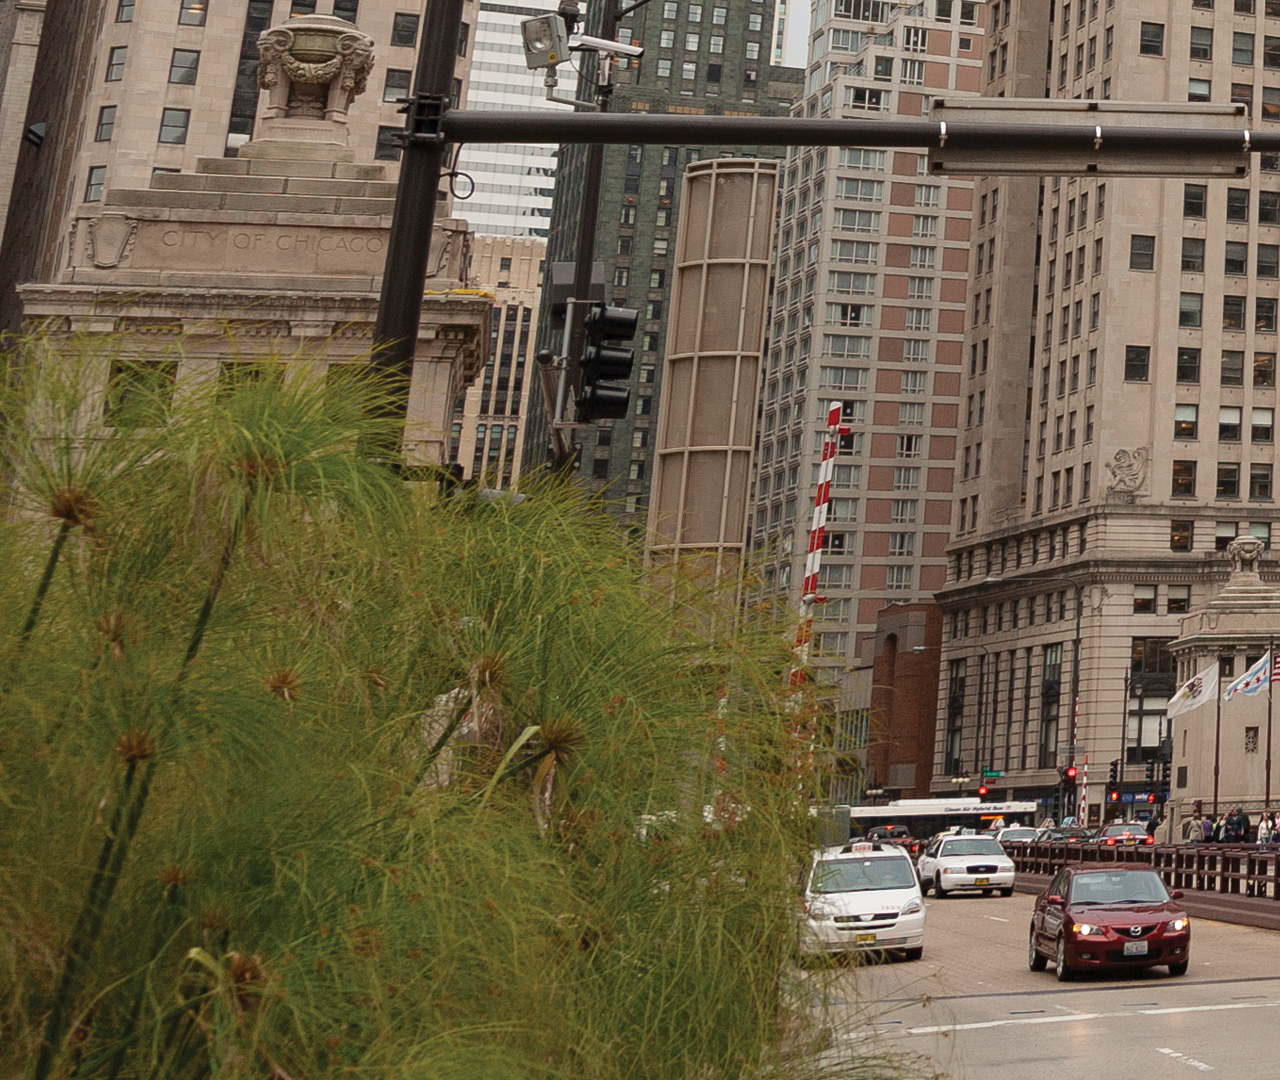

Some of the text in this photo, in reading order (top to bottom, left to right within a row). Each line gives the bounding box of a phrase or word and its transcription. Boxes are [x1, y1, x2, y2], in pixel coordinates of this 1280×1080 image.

[162, 230, 384, 252] CITY OF CHICAGO
